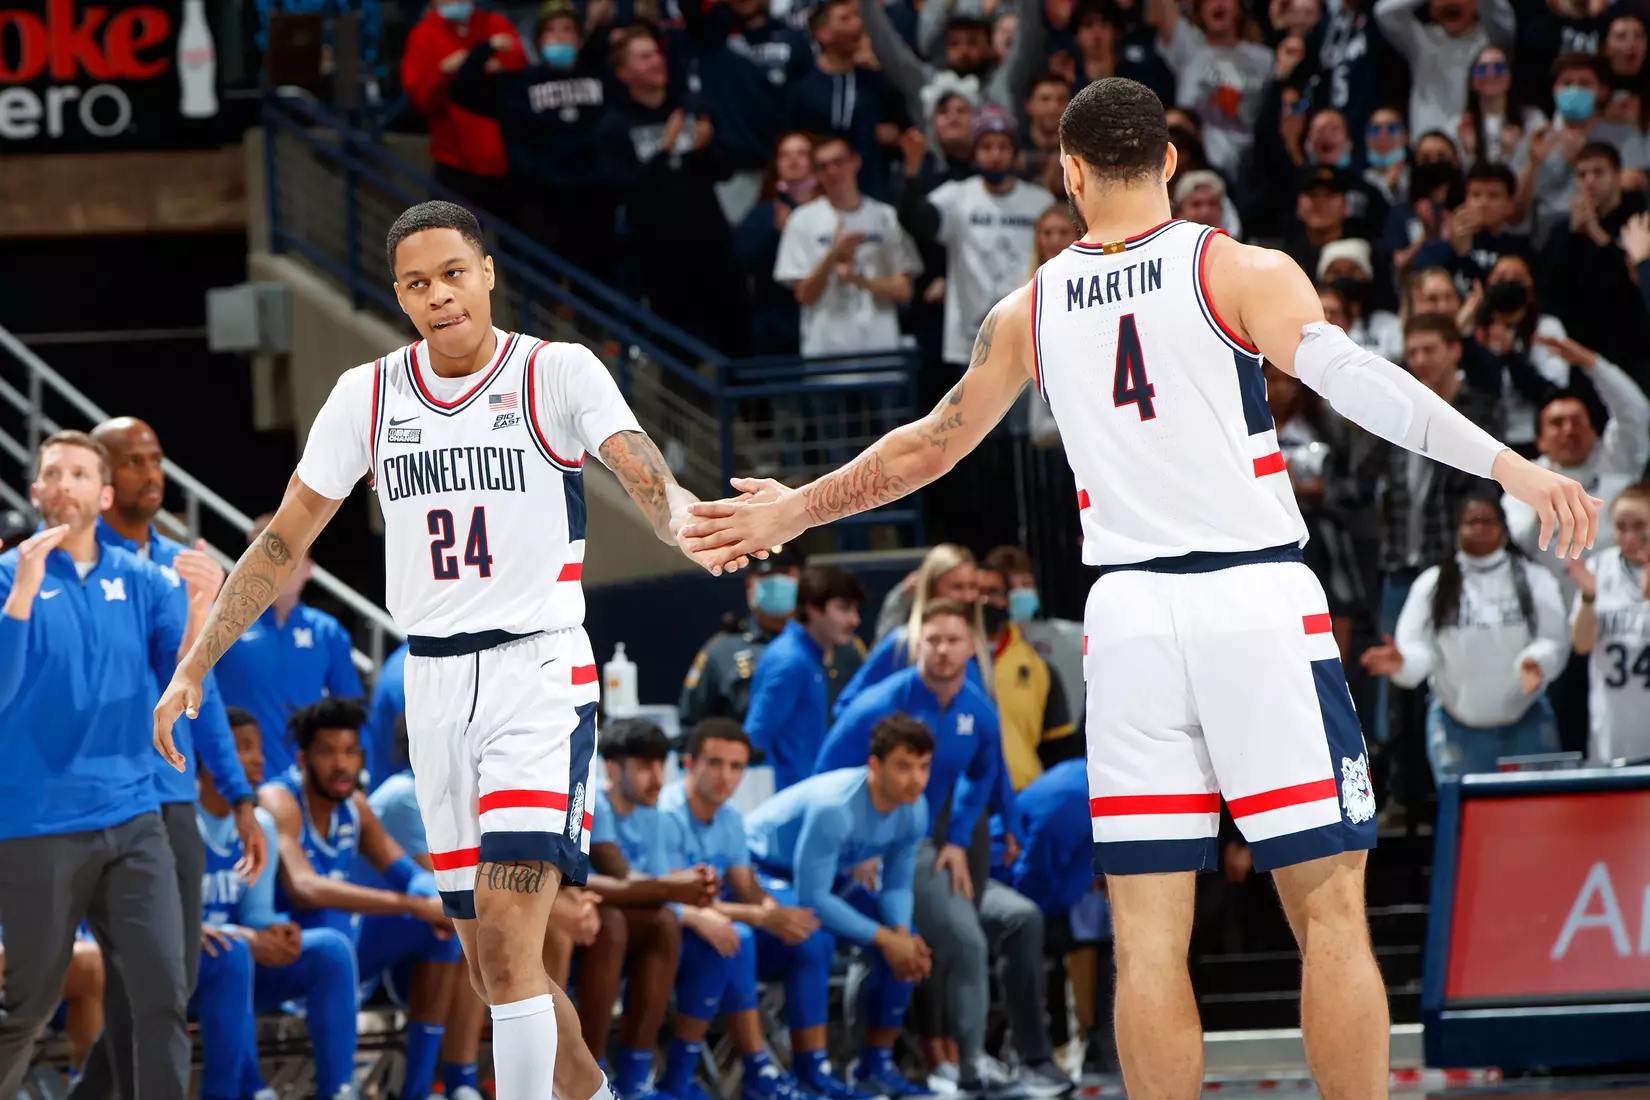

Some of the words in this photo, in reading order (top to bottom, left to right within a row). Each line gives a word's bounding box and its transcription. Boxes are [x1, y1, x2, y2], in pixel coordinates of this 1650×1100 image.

[0, 84, 133, 138] ero
[1066, 258, 1163, 313] MARTIN
[1112, 312, 1157, 422] 4
[493, 417, 521, 427] EAST
[495, 412, 515, 421] BIG
[383, 446, 526, 502] CONNECTICUT
[426, 505, 493, 581] 24
[1605, 642, 1650, 690] 34
[1550, 860, 1650, 959] A
